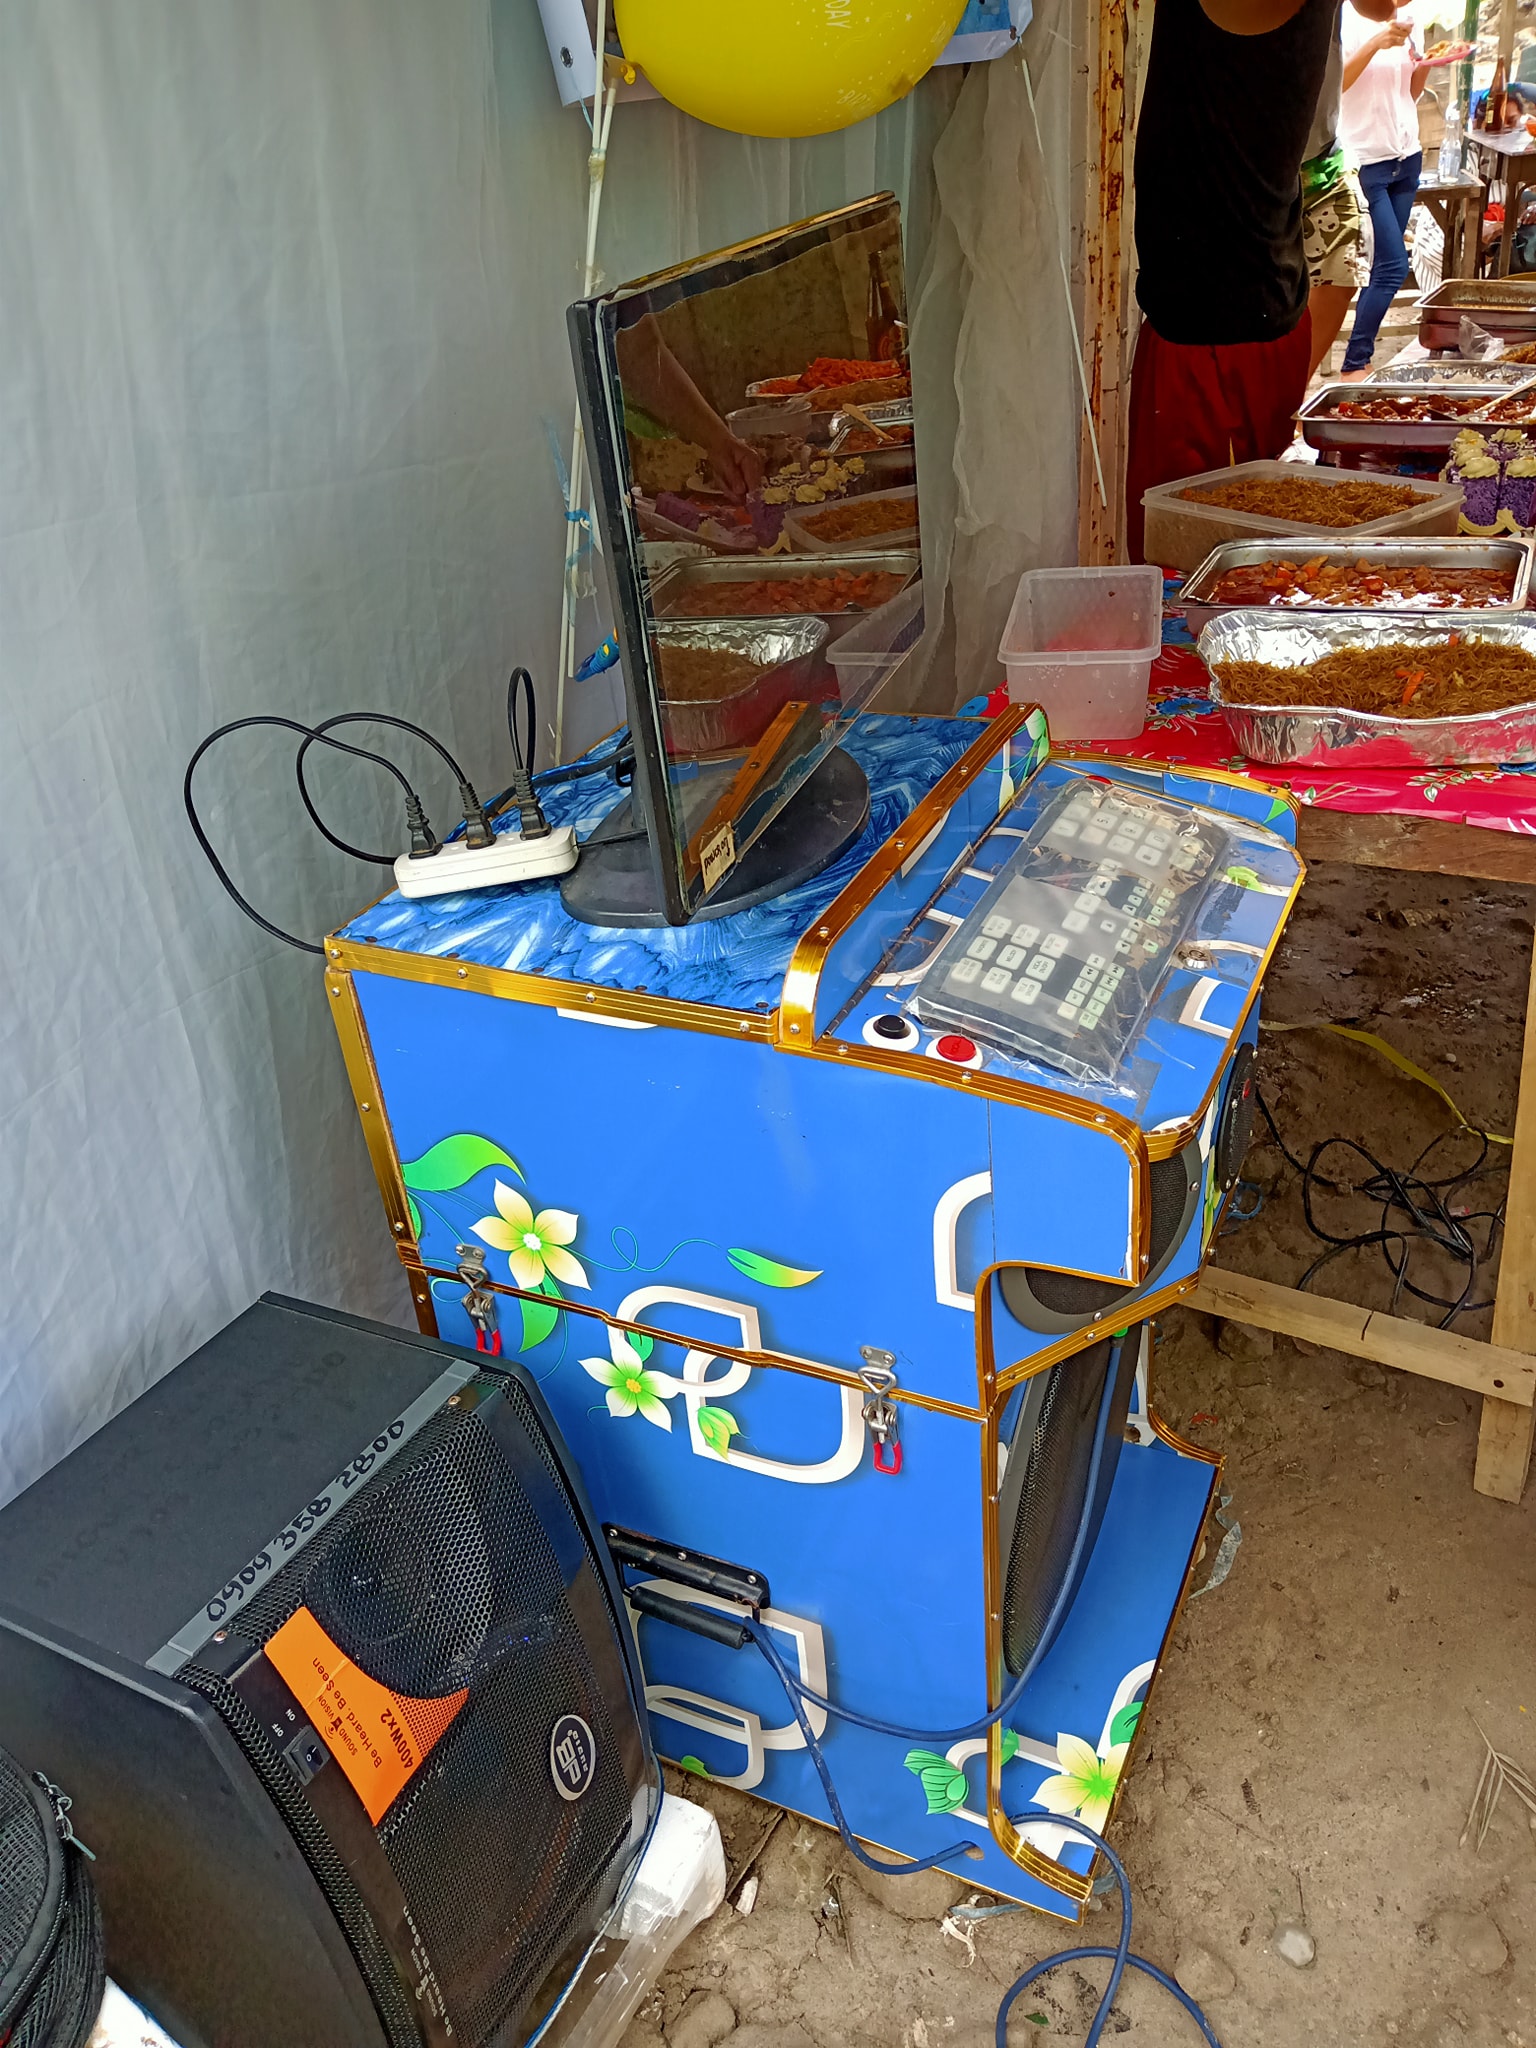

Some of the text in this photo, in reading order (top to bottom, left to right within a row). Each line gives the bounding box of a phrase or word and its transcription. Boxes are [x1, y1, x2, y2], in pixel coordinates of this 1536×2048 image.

[206, 1420, 405, 1622] 0909 358 2800
[312, 1657, 335, 1691] Seen
[333, 1690, 347, 1710] Be
[285, 1708, 296, 1721] ON
[317, 1694, 358, 1756] SOUND VISION
[271, 1723, 284, 1737] OFF
[370, 1749, 382, 1769] Be
[402, 1905, 421, 1947] Seen
[444, 2016, 453, 2037] Be
